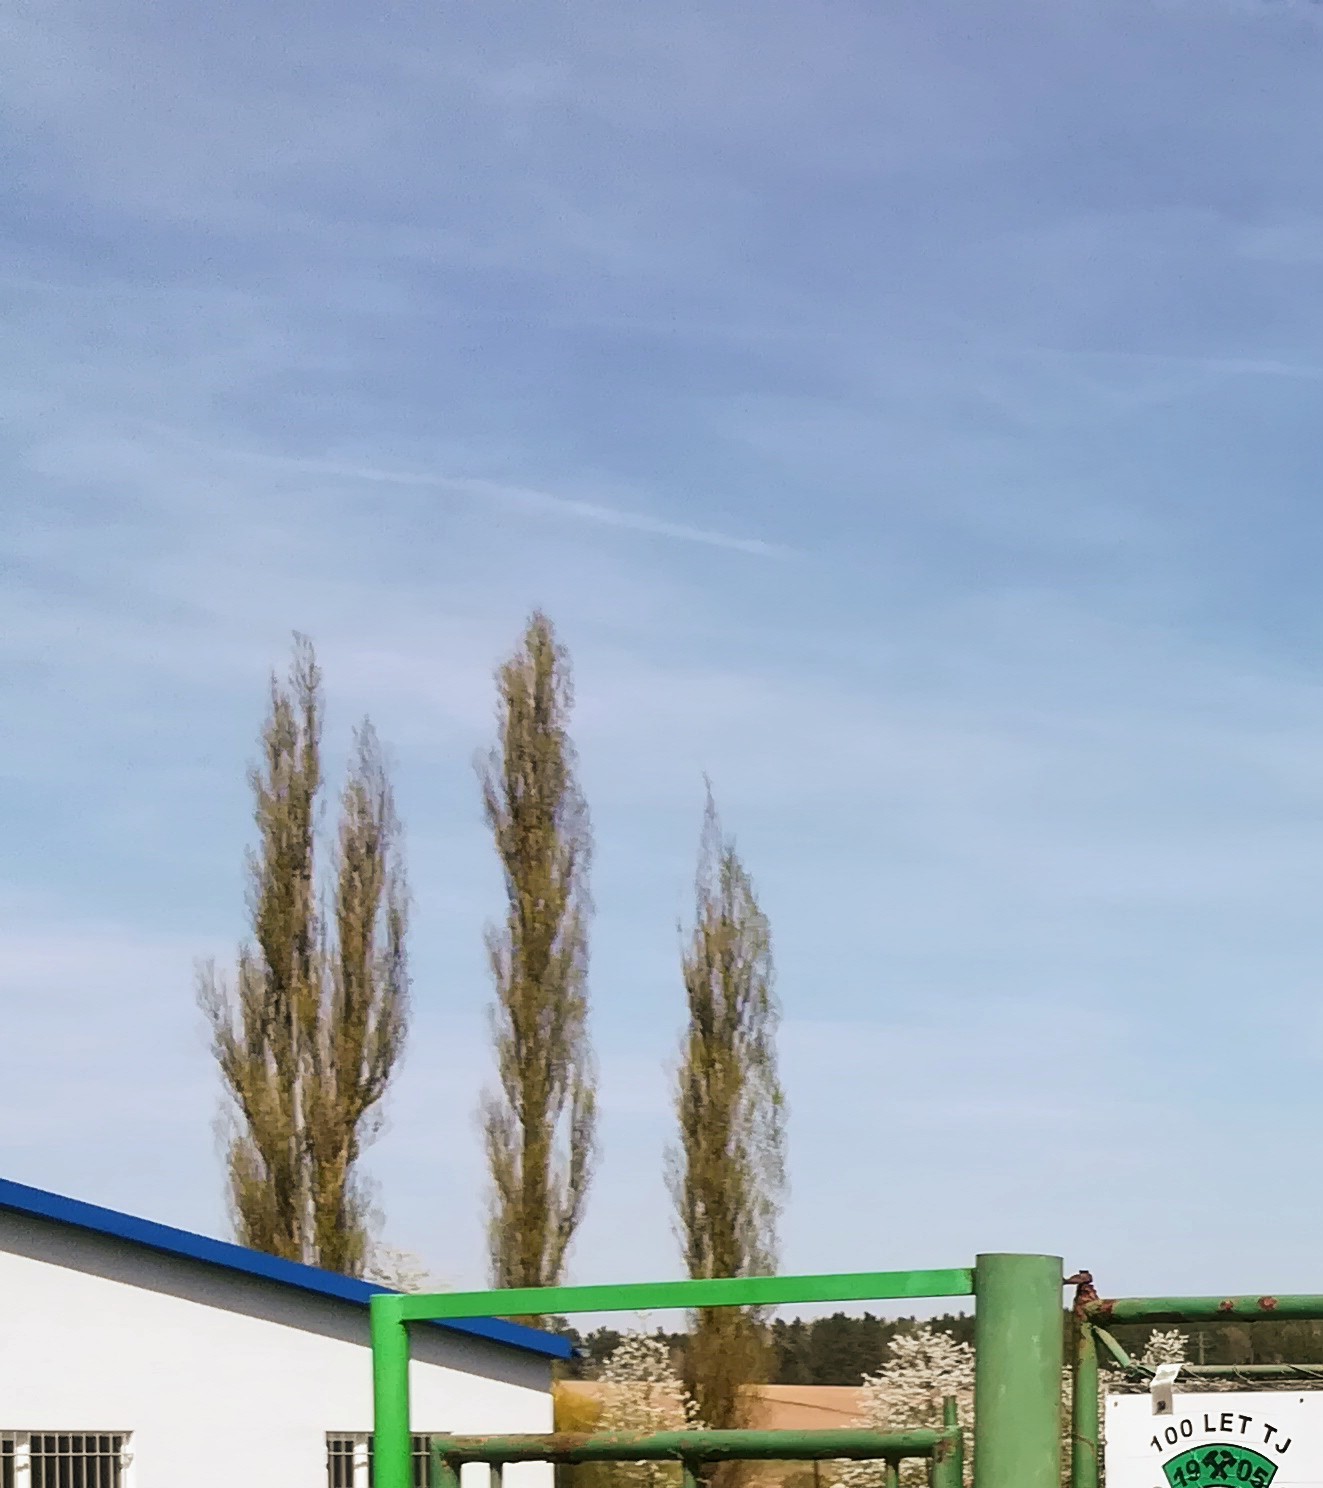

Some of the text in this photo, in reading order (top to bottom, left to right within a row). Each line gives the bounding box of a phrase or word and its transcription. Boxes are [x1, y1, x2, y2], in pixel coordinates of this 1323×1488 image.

[1150, 1413, 1292, 1454] 100 LET TJ
